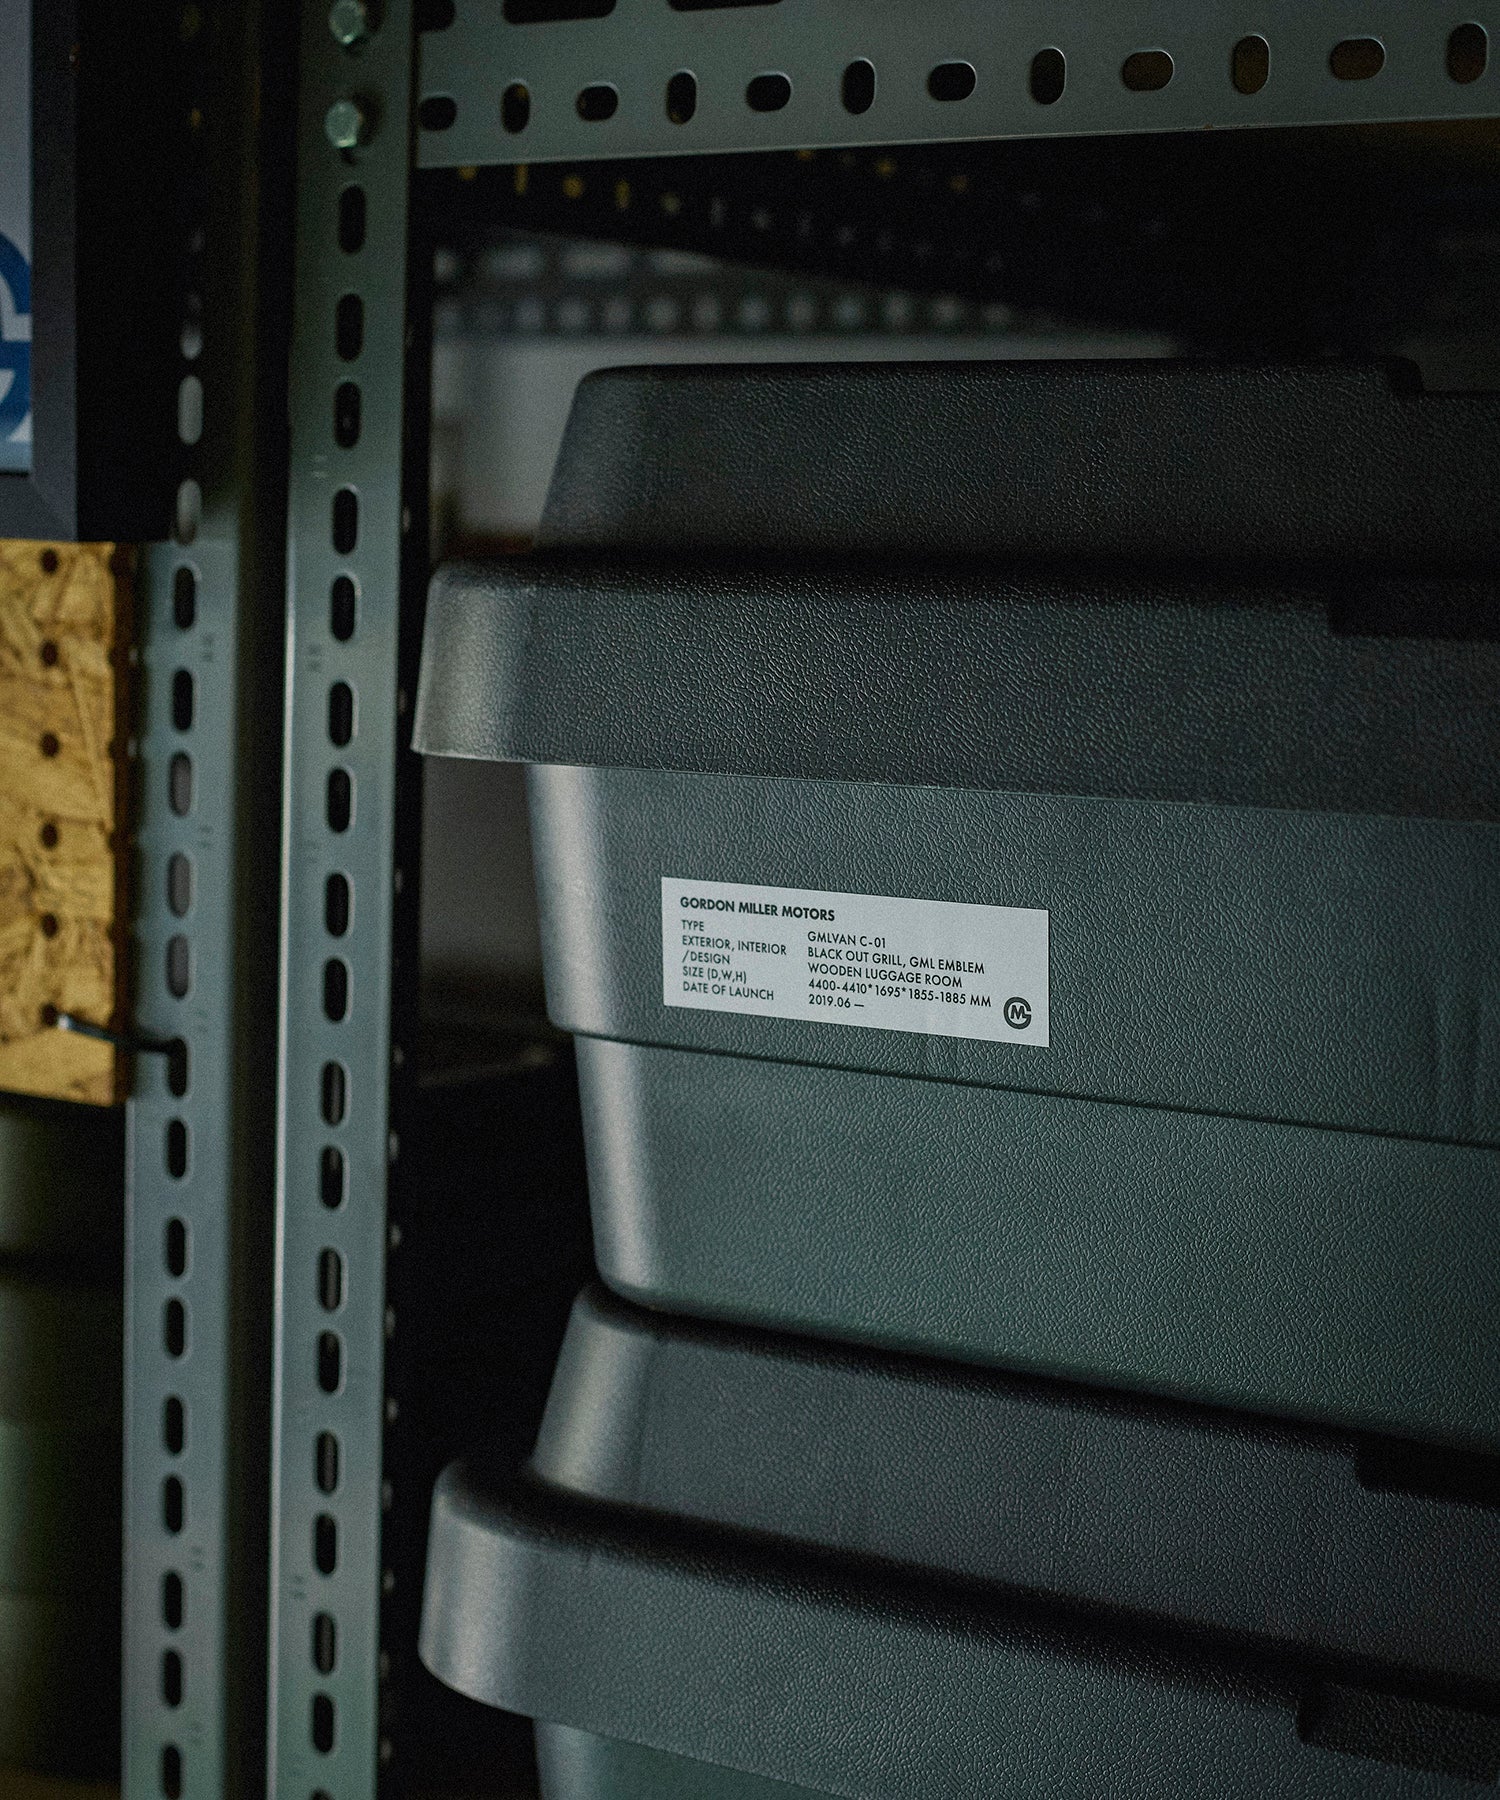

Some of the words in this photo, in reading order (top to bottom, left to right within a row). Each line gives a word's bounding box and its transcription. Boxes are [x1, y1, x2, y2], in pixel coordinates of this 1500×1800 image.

[680, 897, 735, 912] GORDON
[738, 902, 778, 916] MILLER
[782, 906, 835, 921] MOTORS
[681, 920, 705, 931] TYPE
[682, 935, 735, 951] EXTERIOR,
[738, 941, 787, 955] INTERIOR
[807, 931, 857, 945] GMLVAN
[859, 936, 886, 948] C-01
[681, 950, 730, 964] /DESIGN
[808, 946, 842, 960] BLACK
[846, 951, 869, 962] OUT
[872, 953, 906, 968] GRILL,
[909, 956, 935, 969] GML
[938, 960, 985, 974] EMBLEM
[682, 966, 704, 977] SIZE
[707, 968, 747, 984] (D,W,H)
[808, 962, 862, 978] WOODEN
[865, 966, 922, 984] LUGGAGE
[925, 974, 962, 988] ROOM
[683, 982, 708, 993] DATE
[712, 985, 726, 995] OF
[729, 987, 774, 1000] LAUNCH
[808, 995, 851, 1008] 2019.06
[970, 995, 991, 1007] MM
